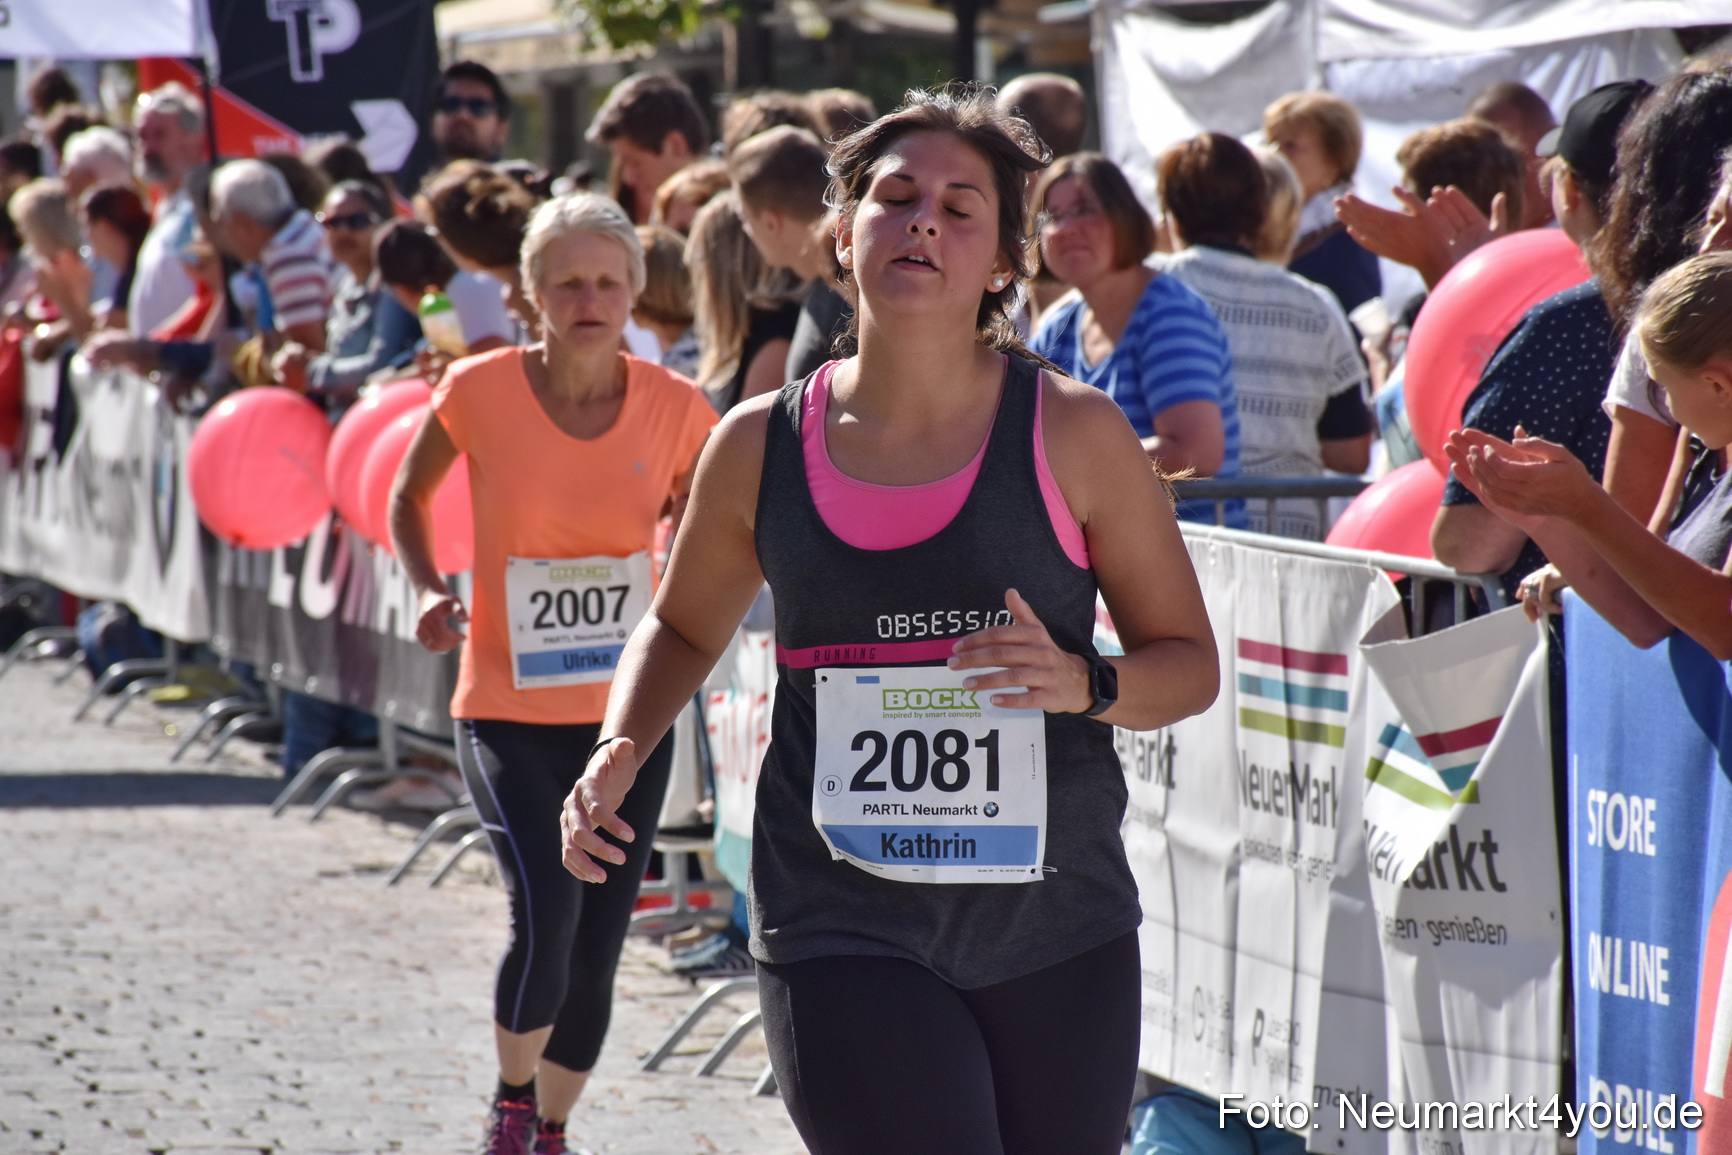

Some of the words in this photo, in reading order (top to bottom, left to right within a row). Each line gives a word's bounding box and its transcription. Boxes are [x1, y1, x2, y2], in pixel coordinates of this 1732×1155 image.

[529, 584, 631, 631] 2007
[877, 610, 1017, 638] OBSESSIO
[563, 652, 611, 670] Ulrike
[814, 648, 876, 662] RUNNING
[883, 688, 980, 710] BOCK
[882, 711, 912, 719] inspired
[914, 711, 923, 719] by
[849, 729, 1000, 792] 2081
[827, 781, 835, 791] D
[863, 804, 909, 815] PARTL
[913, 804, 978, 815] Neumarkt
[1588, 788, 1657, 856] STORE
[881, 833, 976, 858] Kathrin
[1426, 916, 1507, 946] genießen
[1588, 931, 1670, 1006] ONLINE
[1589, 1075, 1675, 1154] OBILE
